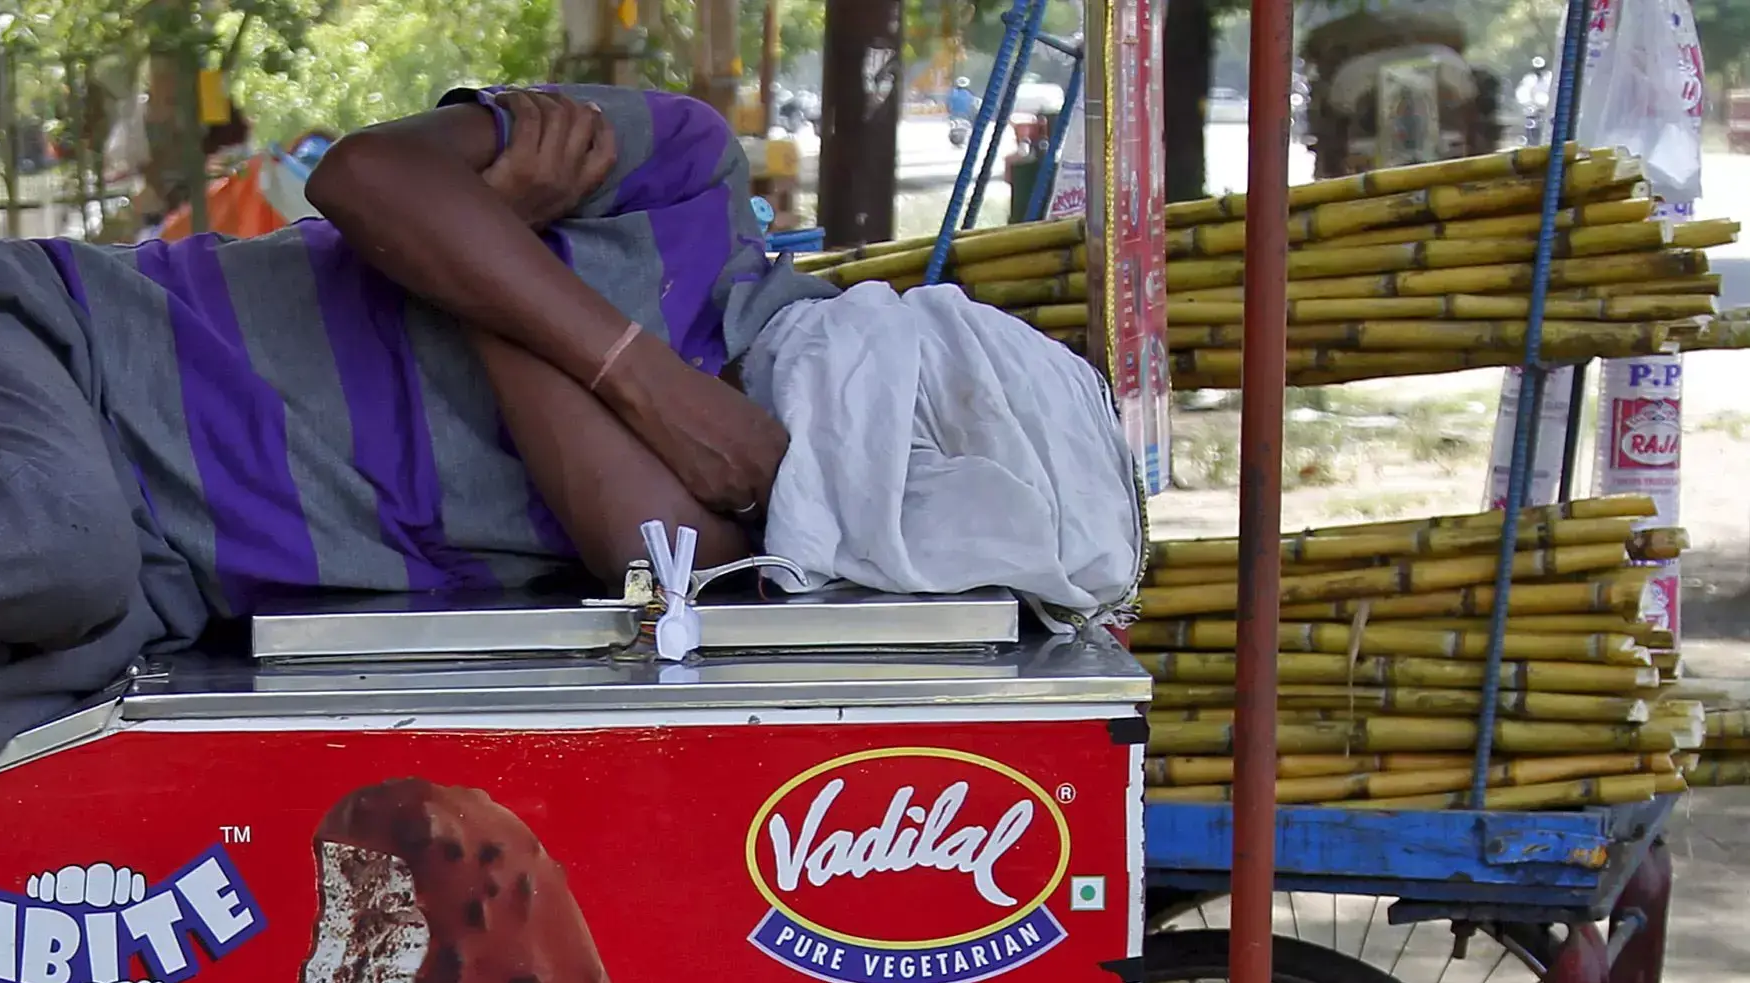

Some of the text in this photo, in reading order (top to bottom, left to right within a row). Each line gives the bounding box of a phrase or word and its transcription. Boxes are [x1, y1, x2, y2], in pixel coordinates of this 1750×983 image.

[768, 778, 1034, 907] Vadilal
[775, 922, 1041, 979] PURE VEGETARIAN
